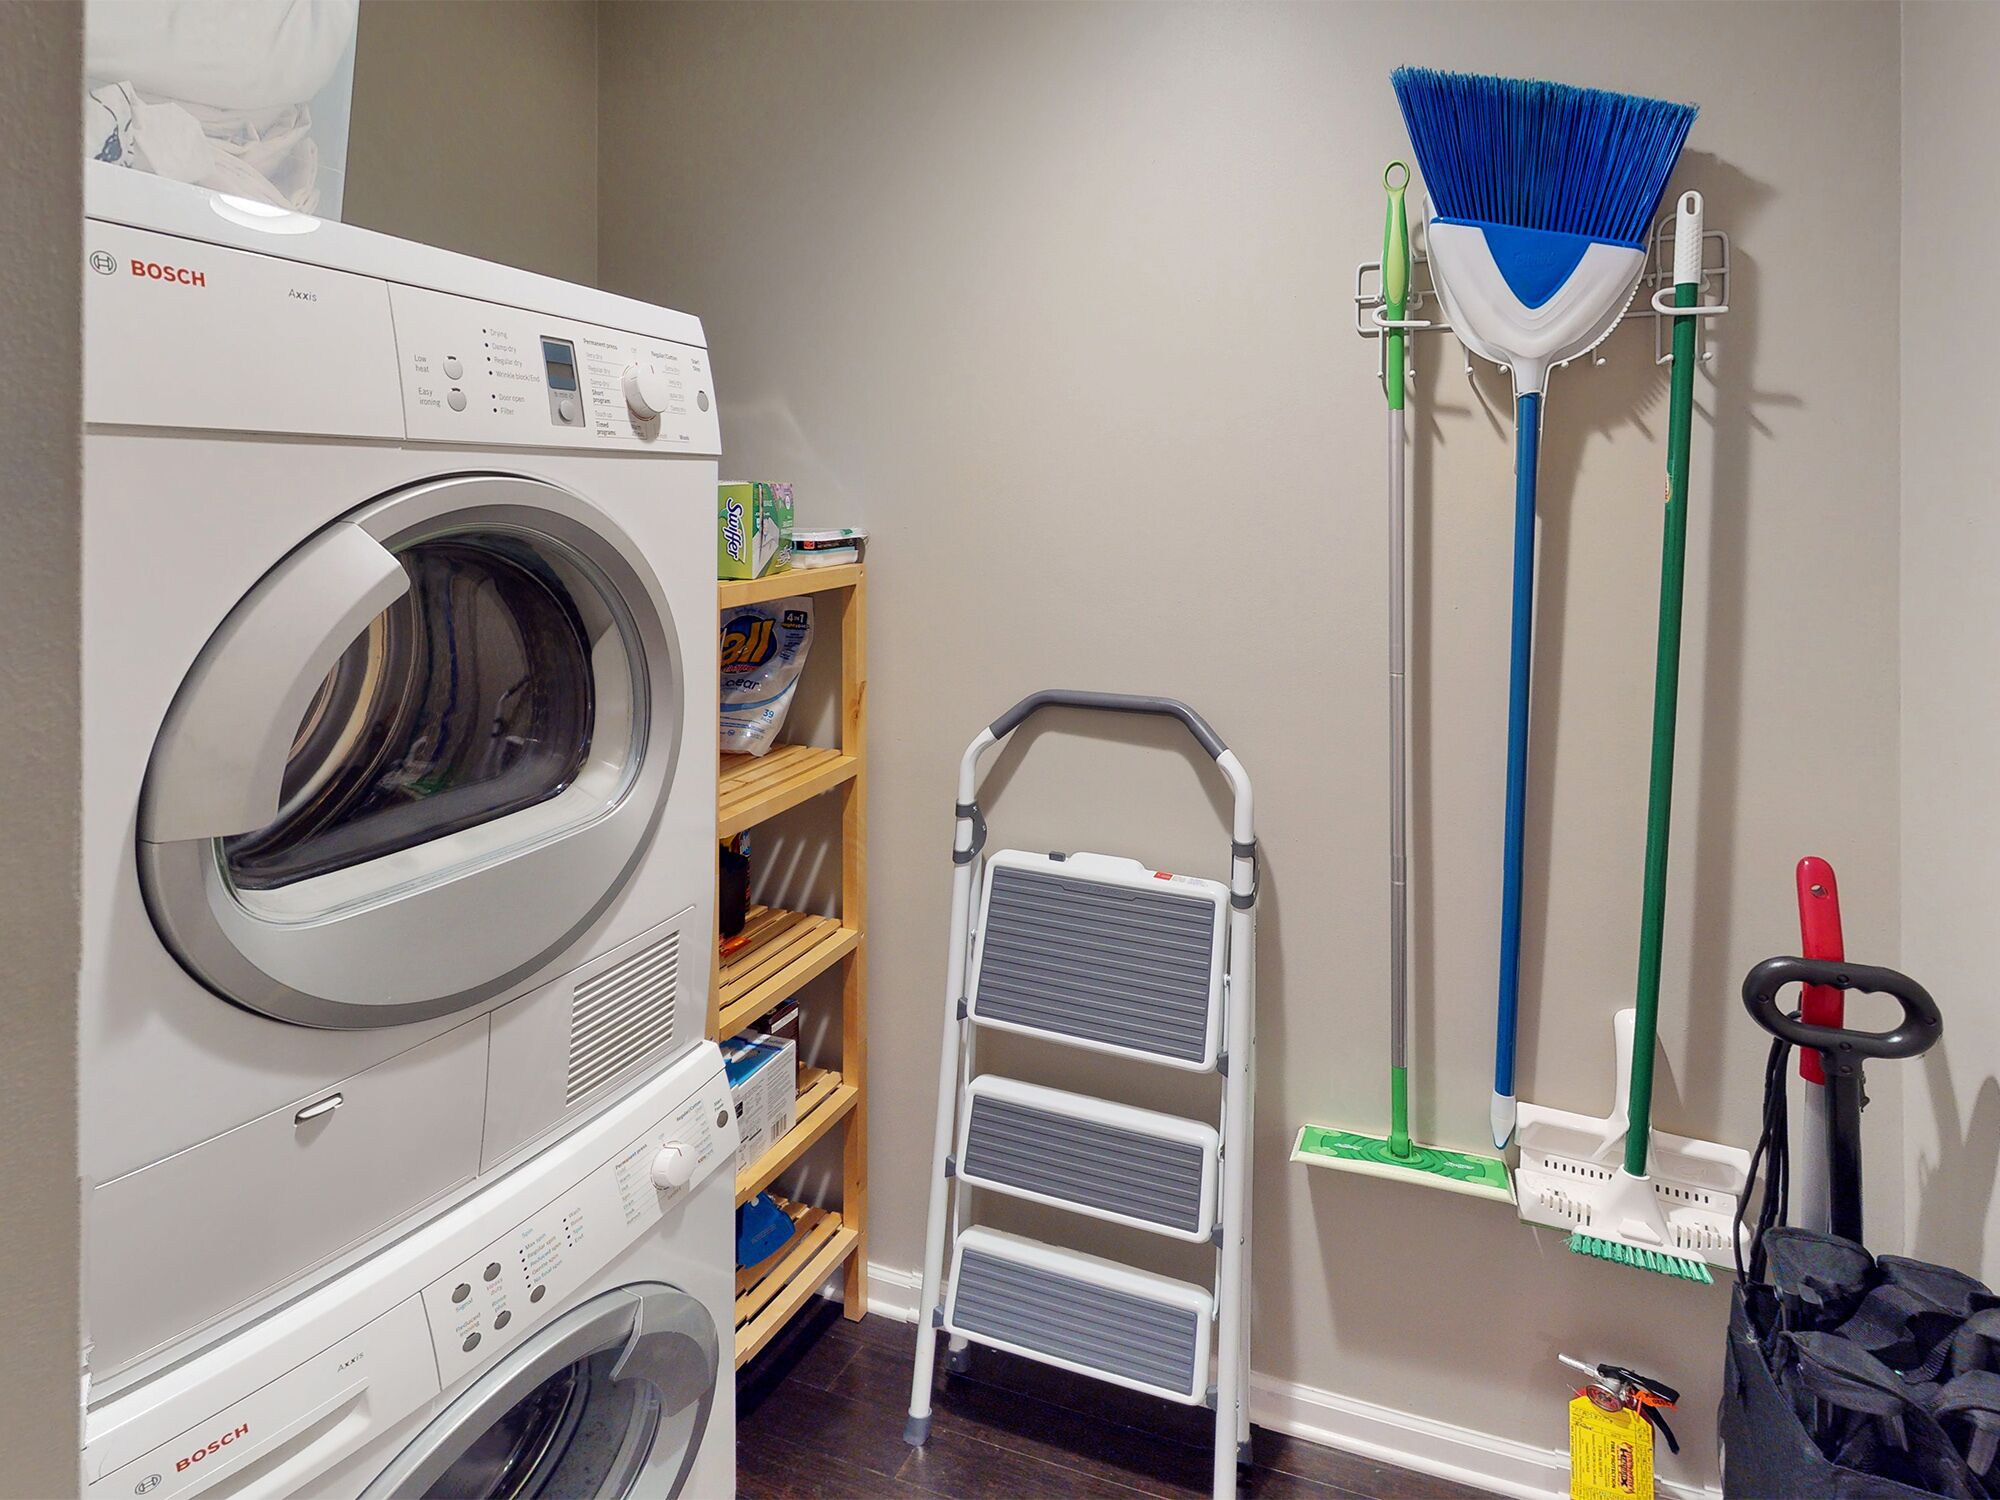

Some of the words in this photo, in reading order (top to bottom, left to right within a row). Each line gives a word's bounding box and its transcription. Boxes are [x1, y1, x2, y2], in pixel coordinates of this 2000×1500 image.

[130, 259, 206, 287] BOSCH
[288, 288, 317, 302] Axxis
[414, 354, 427, 363] Low
[415, 365, 429, 373] heat
[418, 387, 433, 397] Easy
[419, 399, 441, 408] ironing
[723, 498, 743, 559] Swiffer
[762, 708, 775, 719] 39
[336, 1351, 365, 1373] Axxis
[175, 1423, 249, 1472] BOSCH
